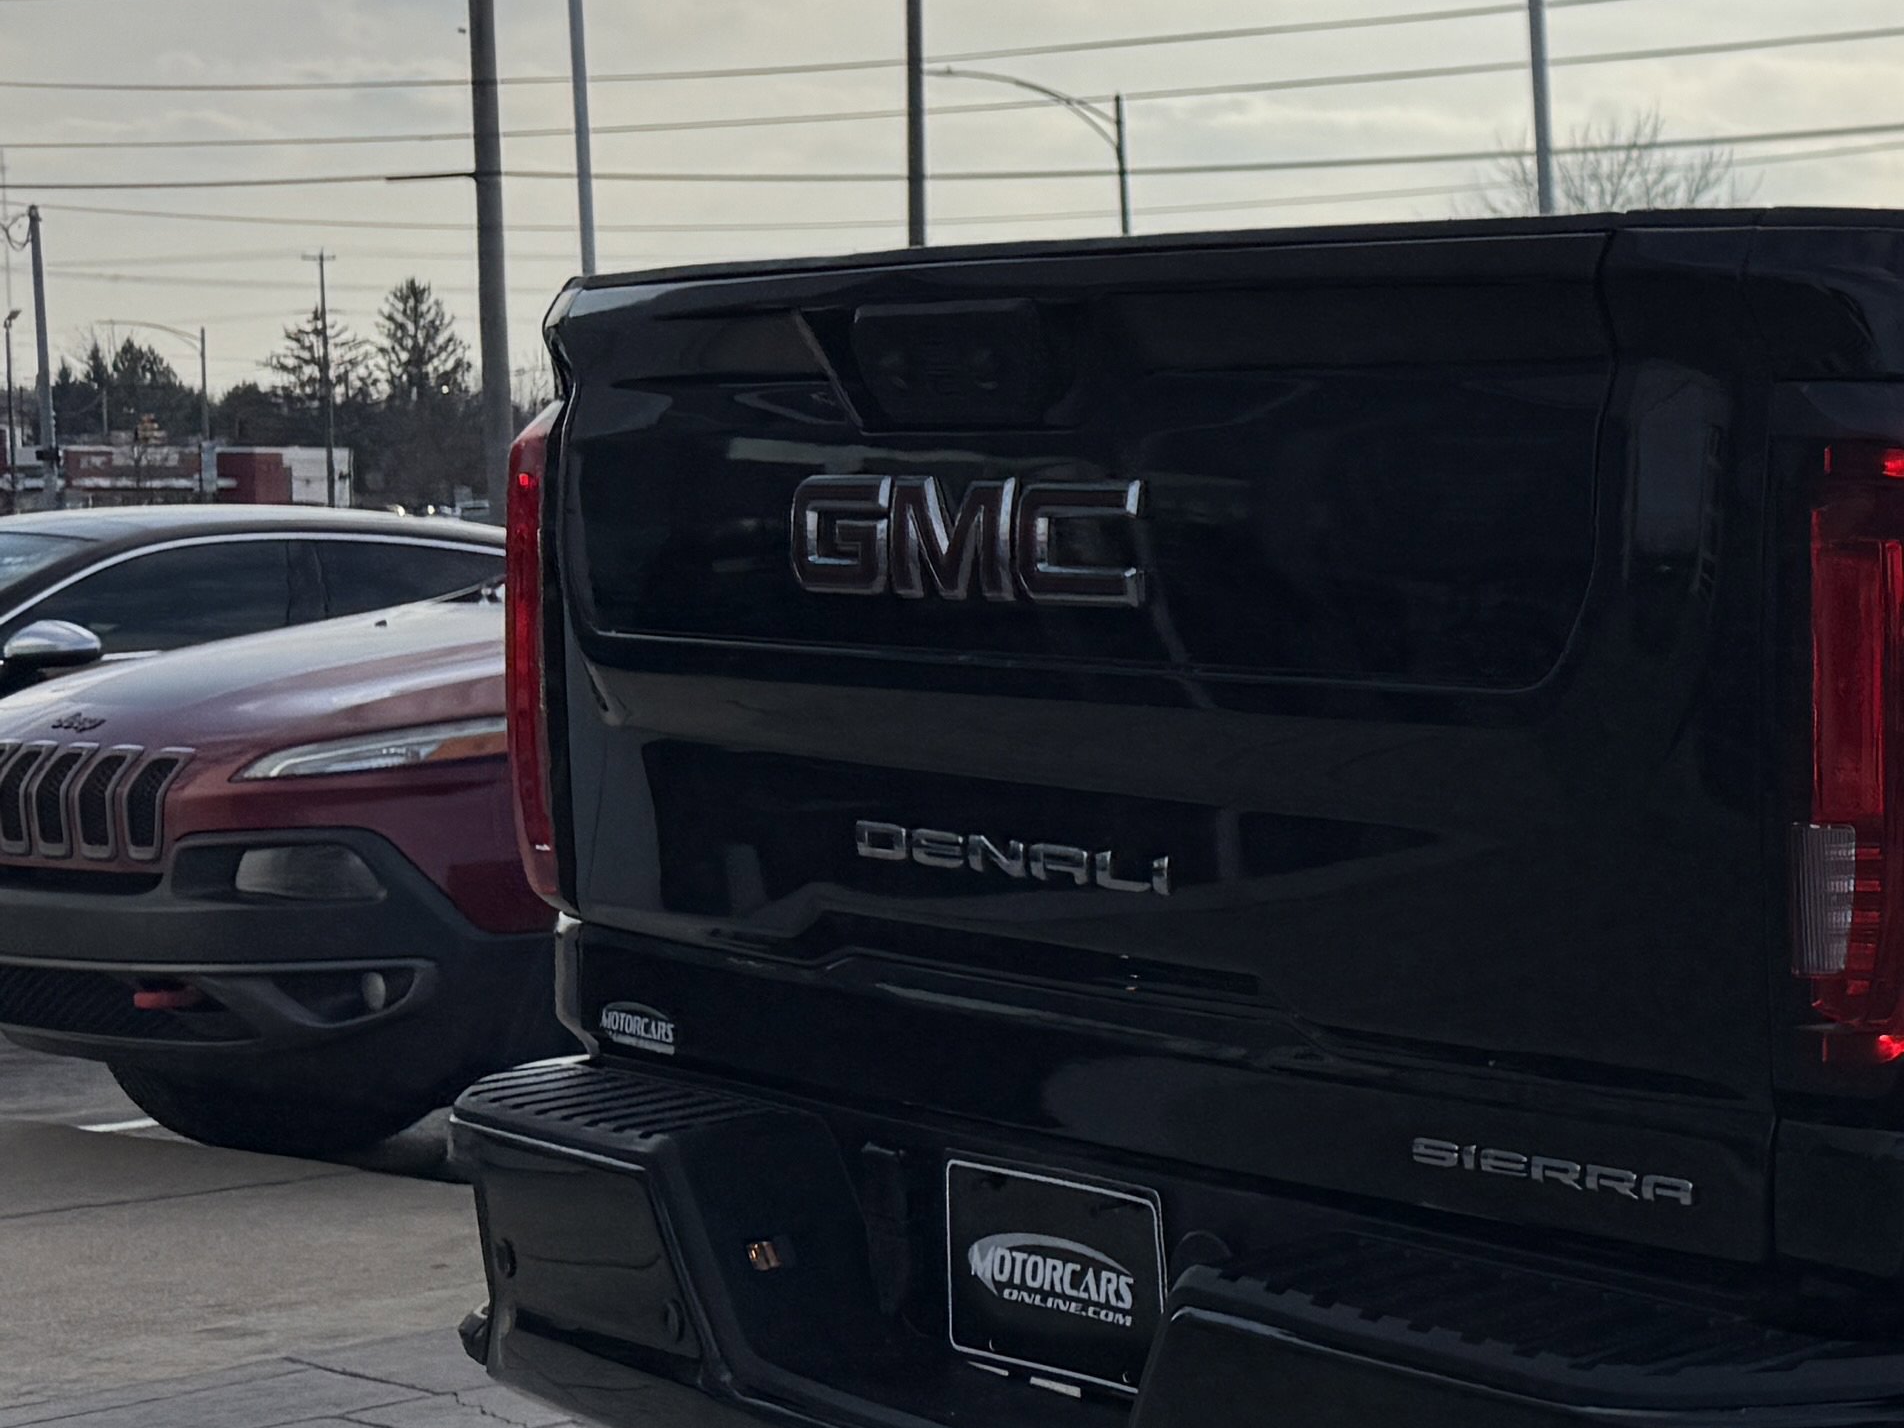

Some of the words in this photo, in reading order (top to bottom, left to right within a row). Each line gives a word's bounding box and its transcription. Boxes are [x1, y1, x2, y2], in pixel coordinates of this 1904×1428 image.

[790, 473, 1148, 608] GMC
[855, 818, 1172, 897] DENALI
[599, 1009, 676, 1044] MOTORCARS
[1411, 1136, 1696, 1207] SIERRA
[969, 1244, 1135, 1310] MOTORCARS
[1002, 1287, 1133, 1328] ONLINE.COM
